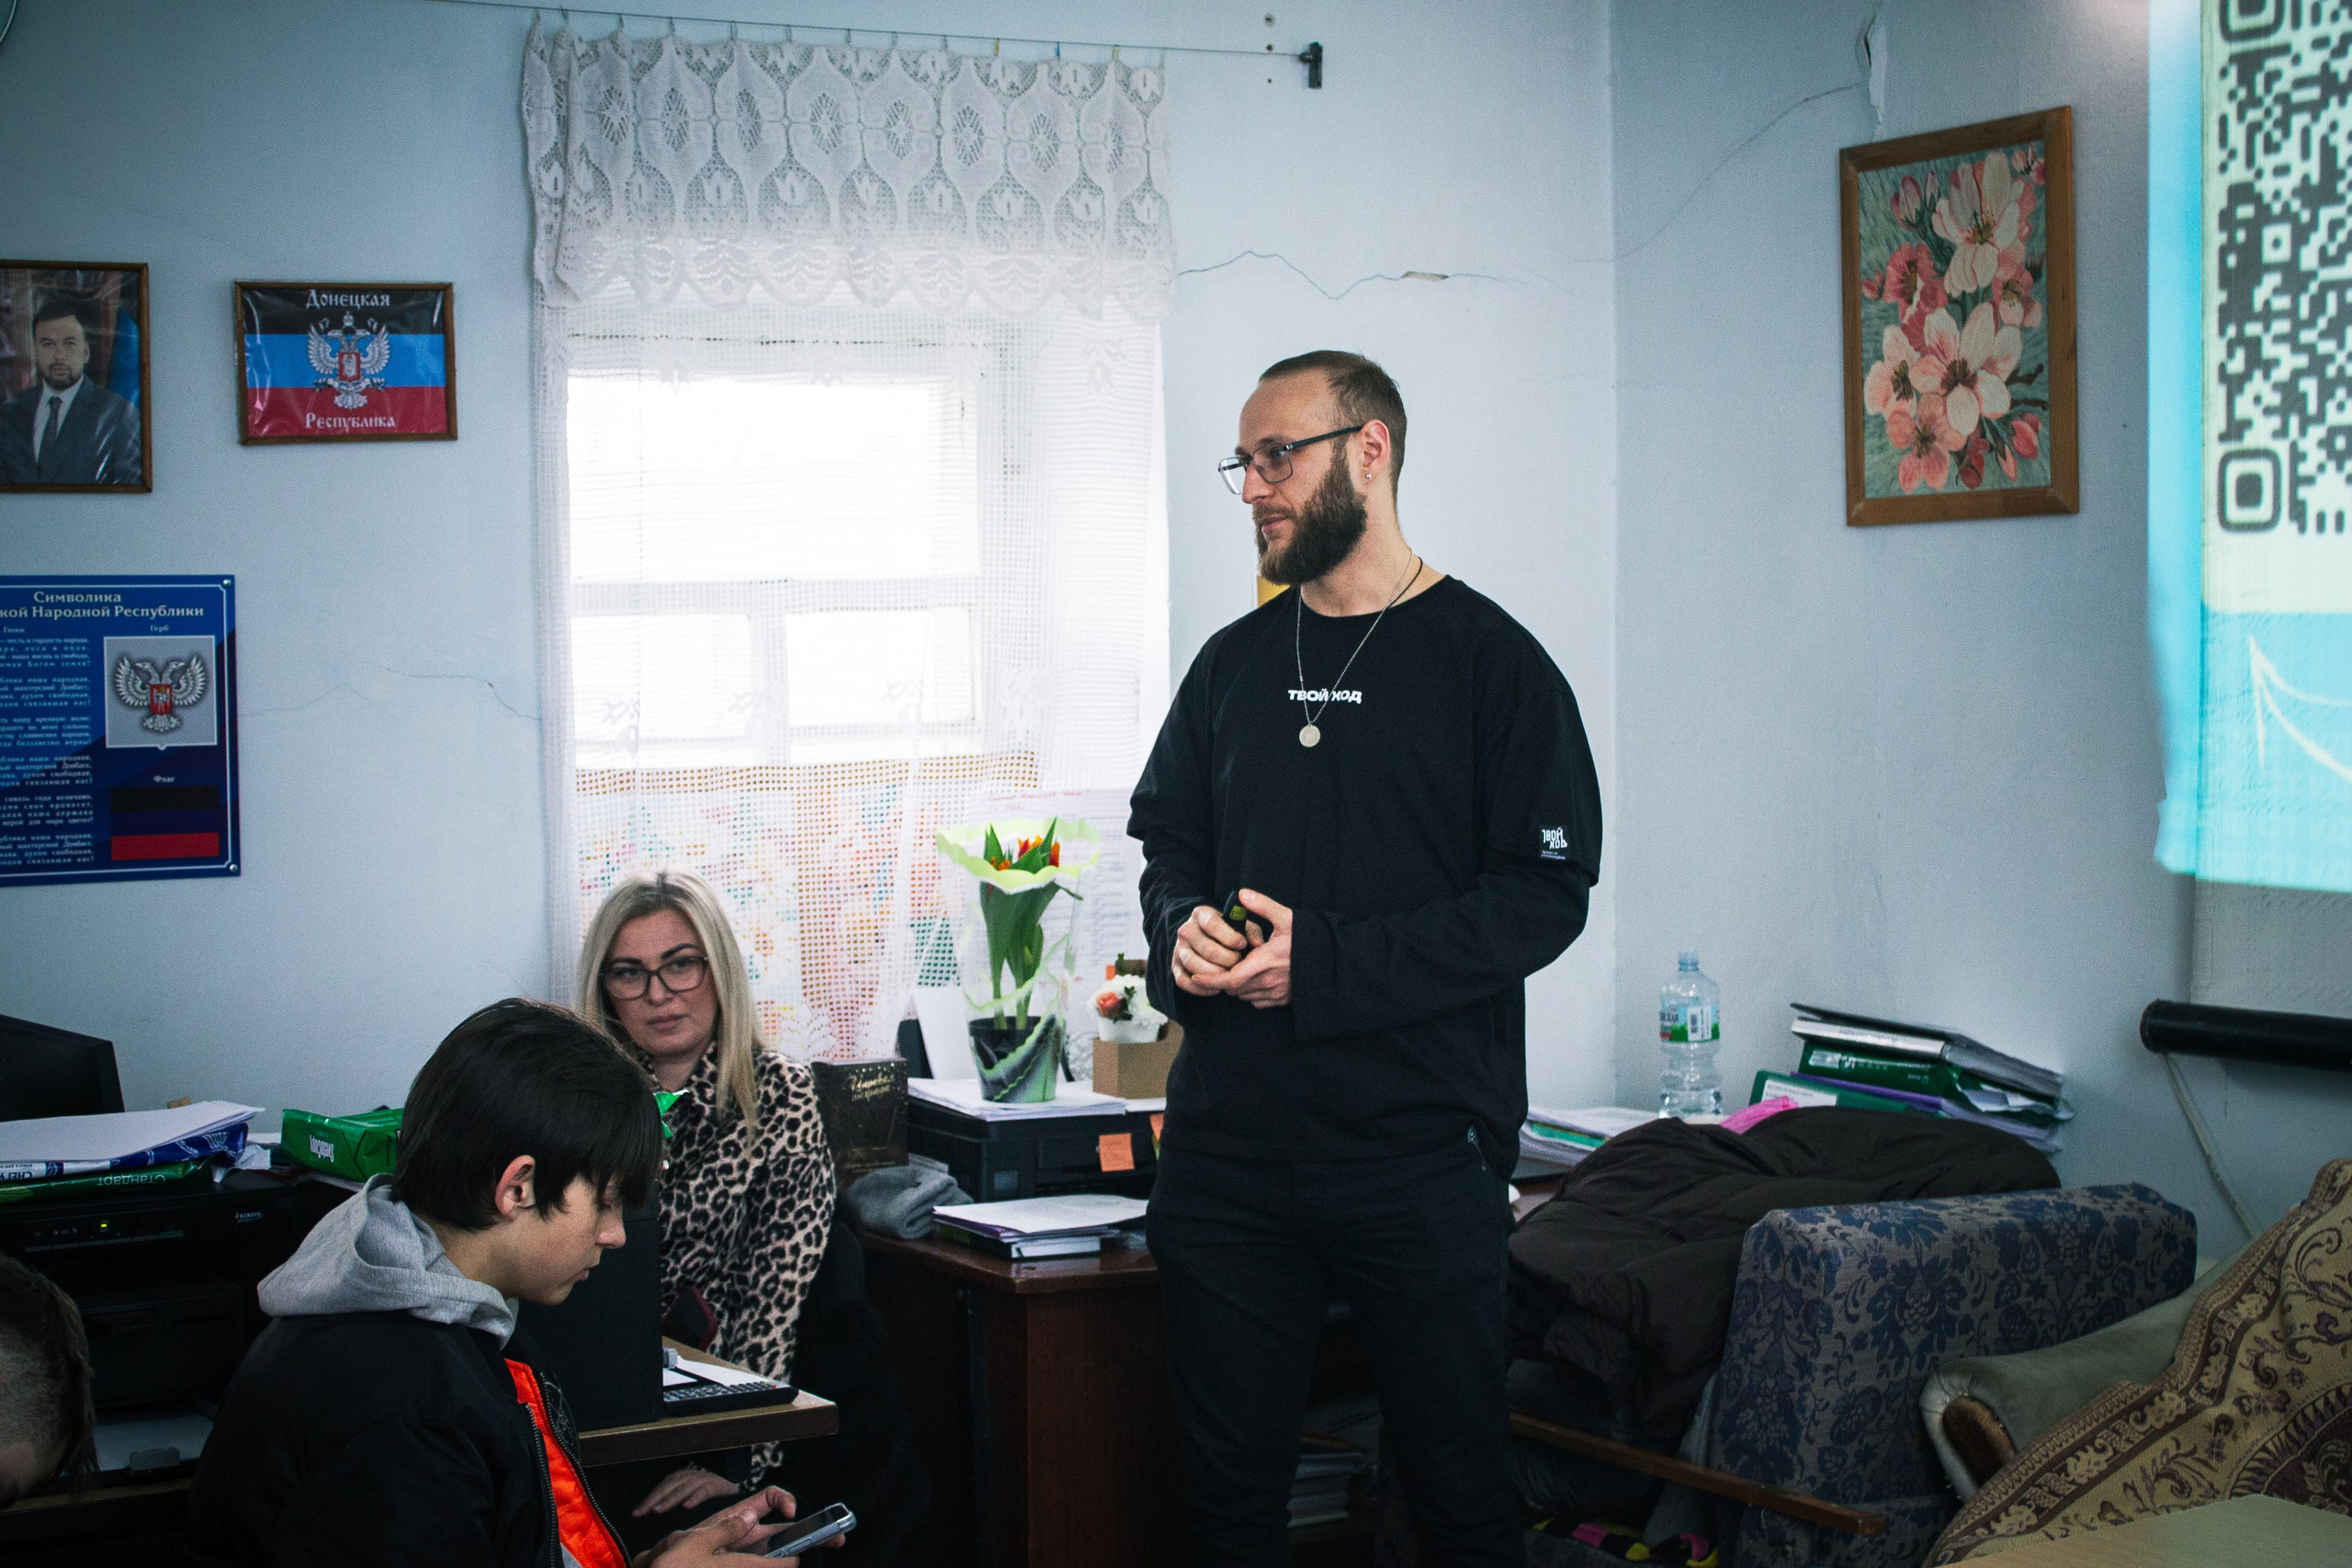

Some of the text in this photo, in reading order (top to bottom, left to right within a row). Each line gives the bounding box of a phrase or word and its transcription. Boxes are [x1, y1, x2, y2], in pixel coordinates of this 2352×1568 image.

[306, 289, 390, 310] Донецкая
[305, 412, 395, 433] Республика
[33, 591, 121, 603] Символика
[32, 606, 110, 620] Народной
[114, 604, 204, 621] Республики
[1287, 688, 1363, 705] ТВОЙ ХОД
[1542, 827, 1564, 843] ТВОЙ
[96, 1173, 166, 1186] Стандарт
